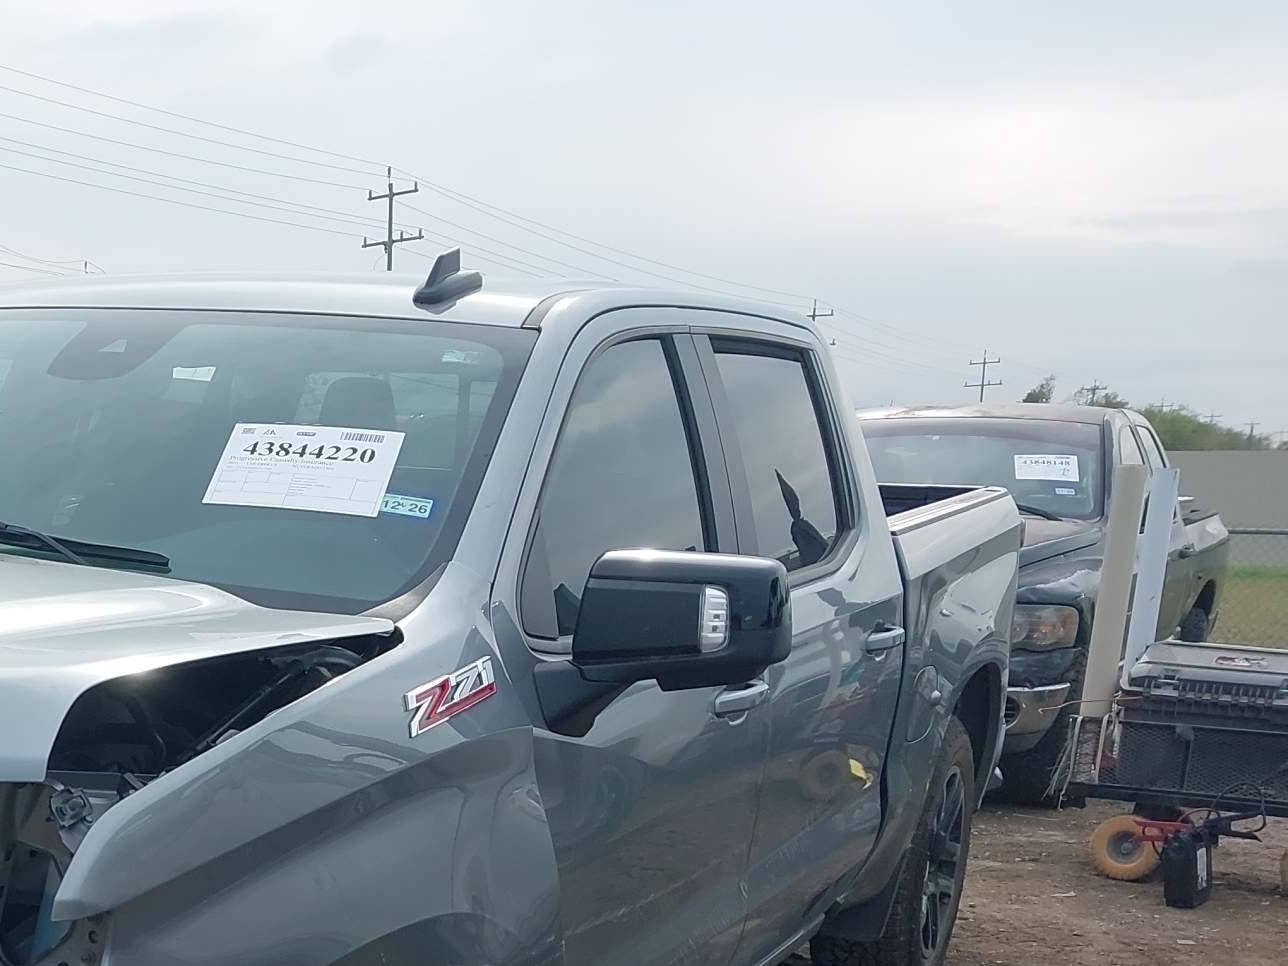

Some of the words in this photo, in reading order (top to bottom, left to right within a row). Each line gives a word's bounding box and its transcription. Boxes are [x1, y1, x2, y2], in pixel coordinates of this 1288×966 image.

[242, 440, 376, 464] 43844220
[383, 499, 401, 510] 12
[408, 503, 429, 514] 26
[401, 655, 497, 739] Z71
